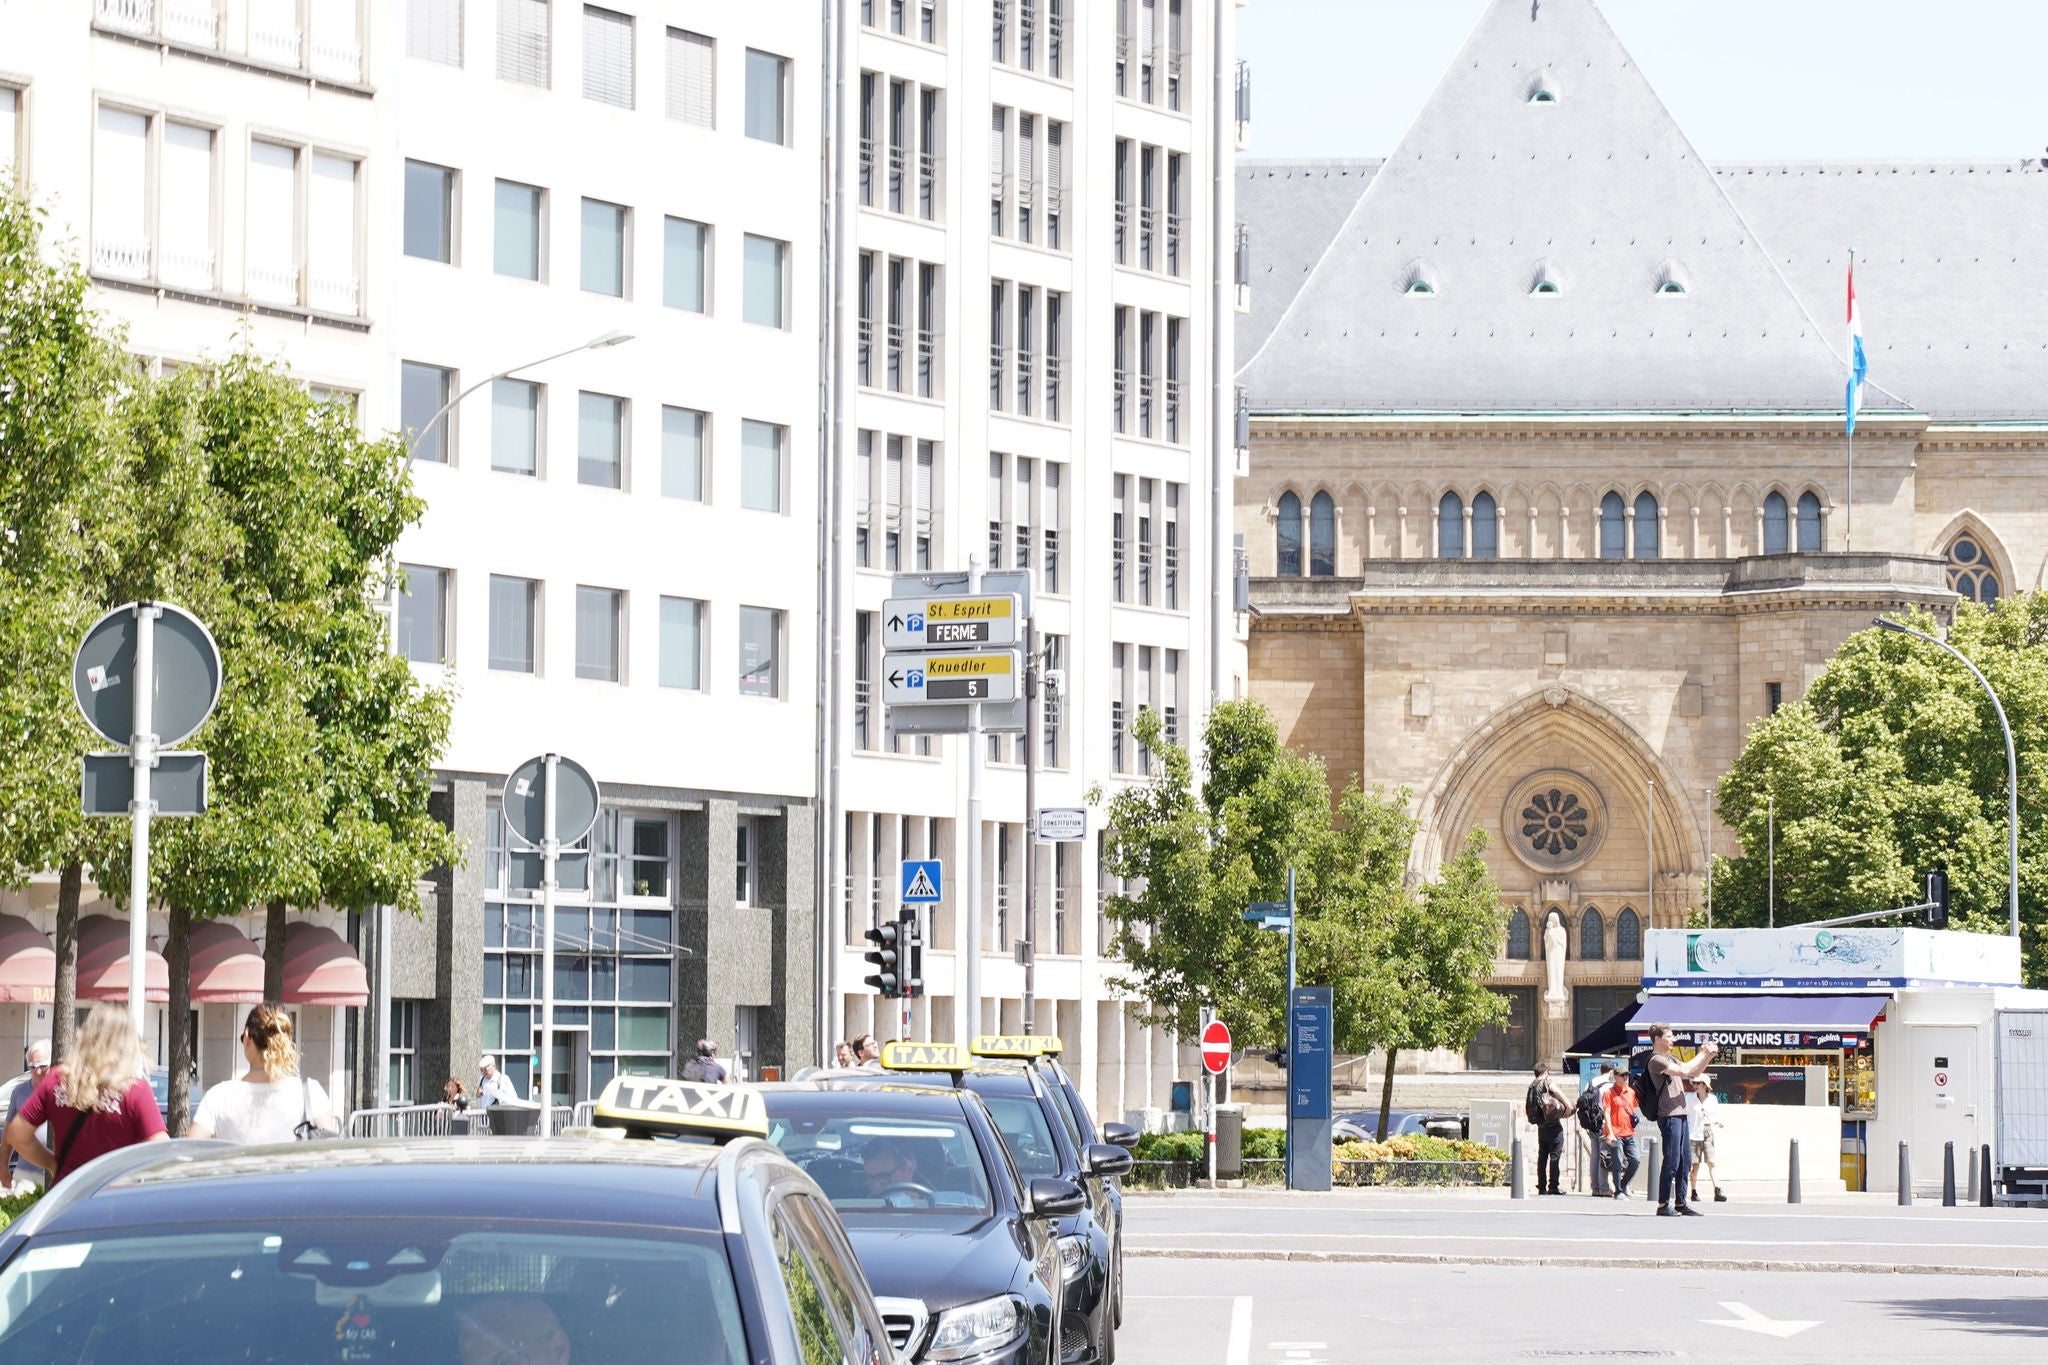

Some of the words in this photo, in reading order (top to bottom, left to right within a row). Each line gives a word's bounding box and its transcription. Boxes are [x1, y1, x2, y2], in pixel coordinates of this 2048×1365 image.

[929, 604, 947, 617] St.
[953, 602, 992, 619] Esprit
[936, 624, 978, 641] FERME
[929, 659, 987, 674] Knuedler
[968, 681, 977, 697] 5
[983, 1038, 1030, 1051] TAXI
[1711, 1032, 1782, 1046] SOUVENIRS
[895, 1046, 955, 1065] TAXI
[621, 1082, 746, 1120] TAXI
